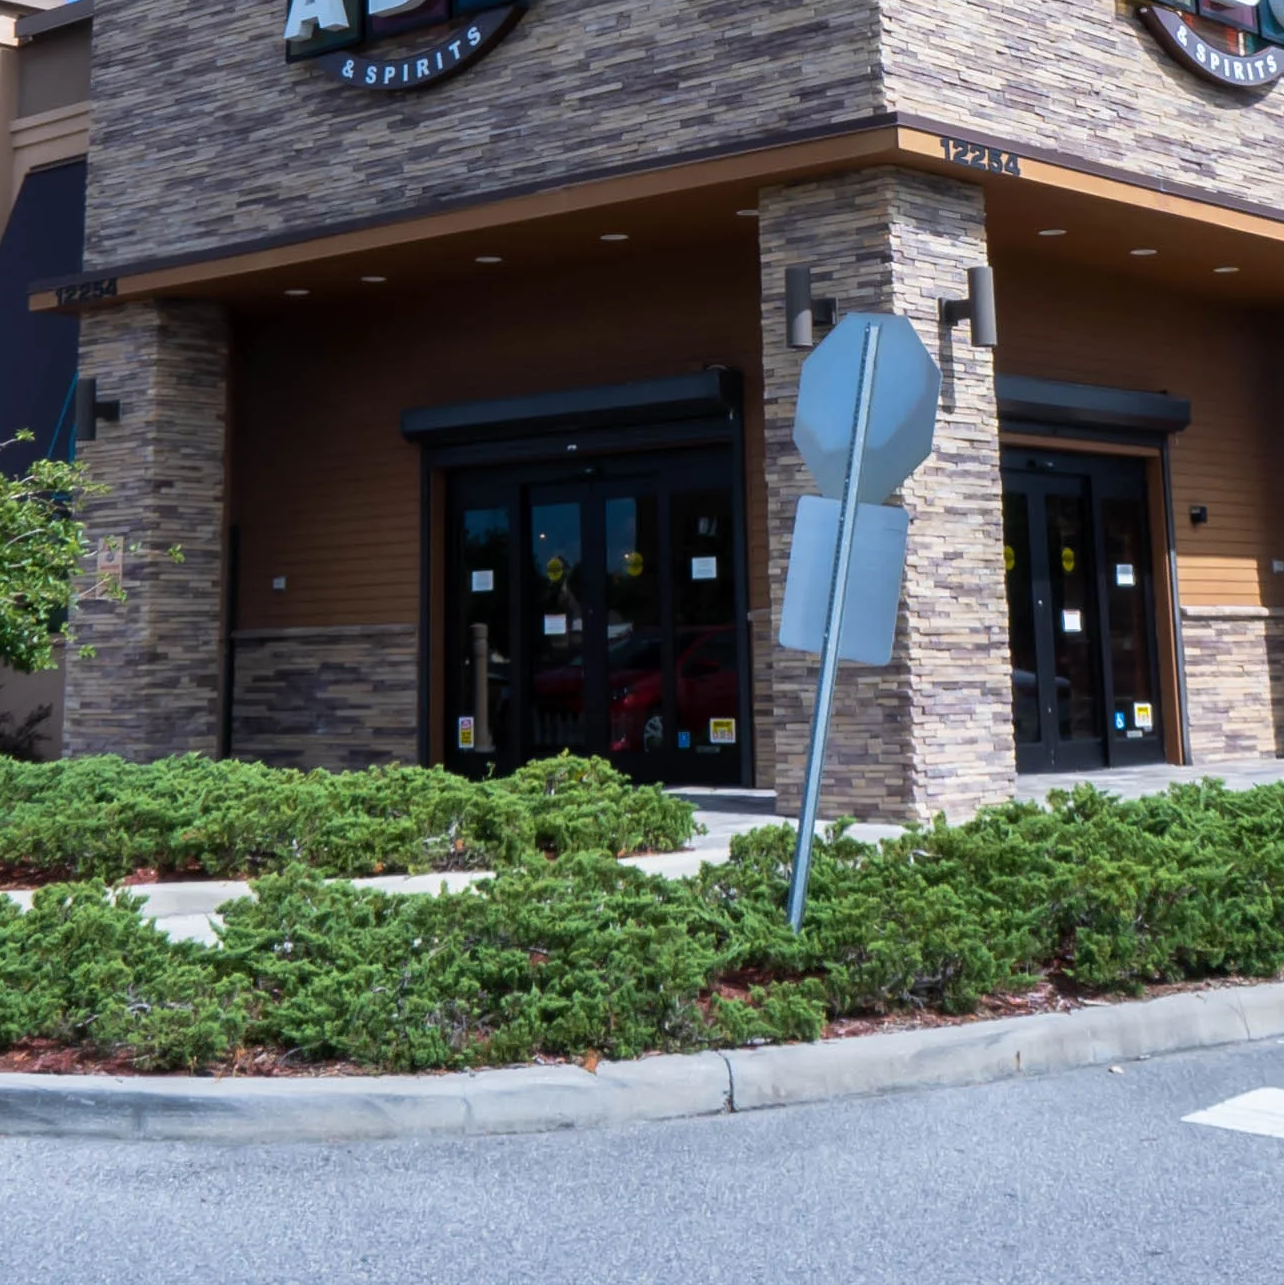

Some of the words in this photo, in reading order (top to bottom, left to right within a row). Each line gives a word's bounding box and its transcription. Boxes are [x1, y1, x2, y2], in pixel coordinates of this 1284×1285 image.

[342, 59, 354, 79] &
[365, 26, 481, 85] SPIRITS
[1177, 25, 1189, 47] &
[1195, 49, 1277, 82] SPIRITS
[940, 137, 1021, 177] 12254
